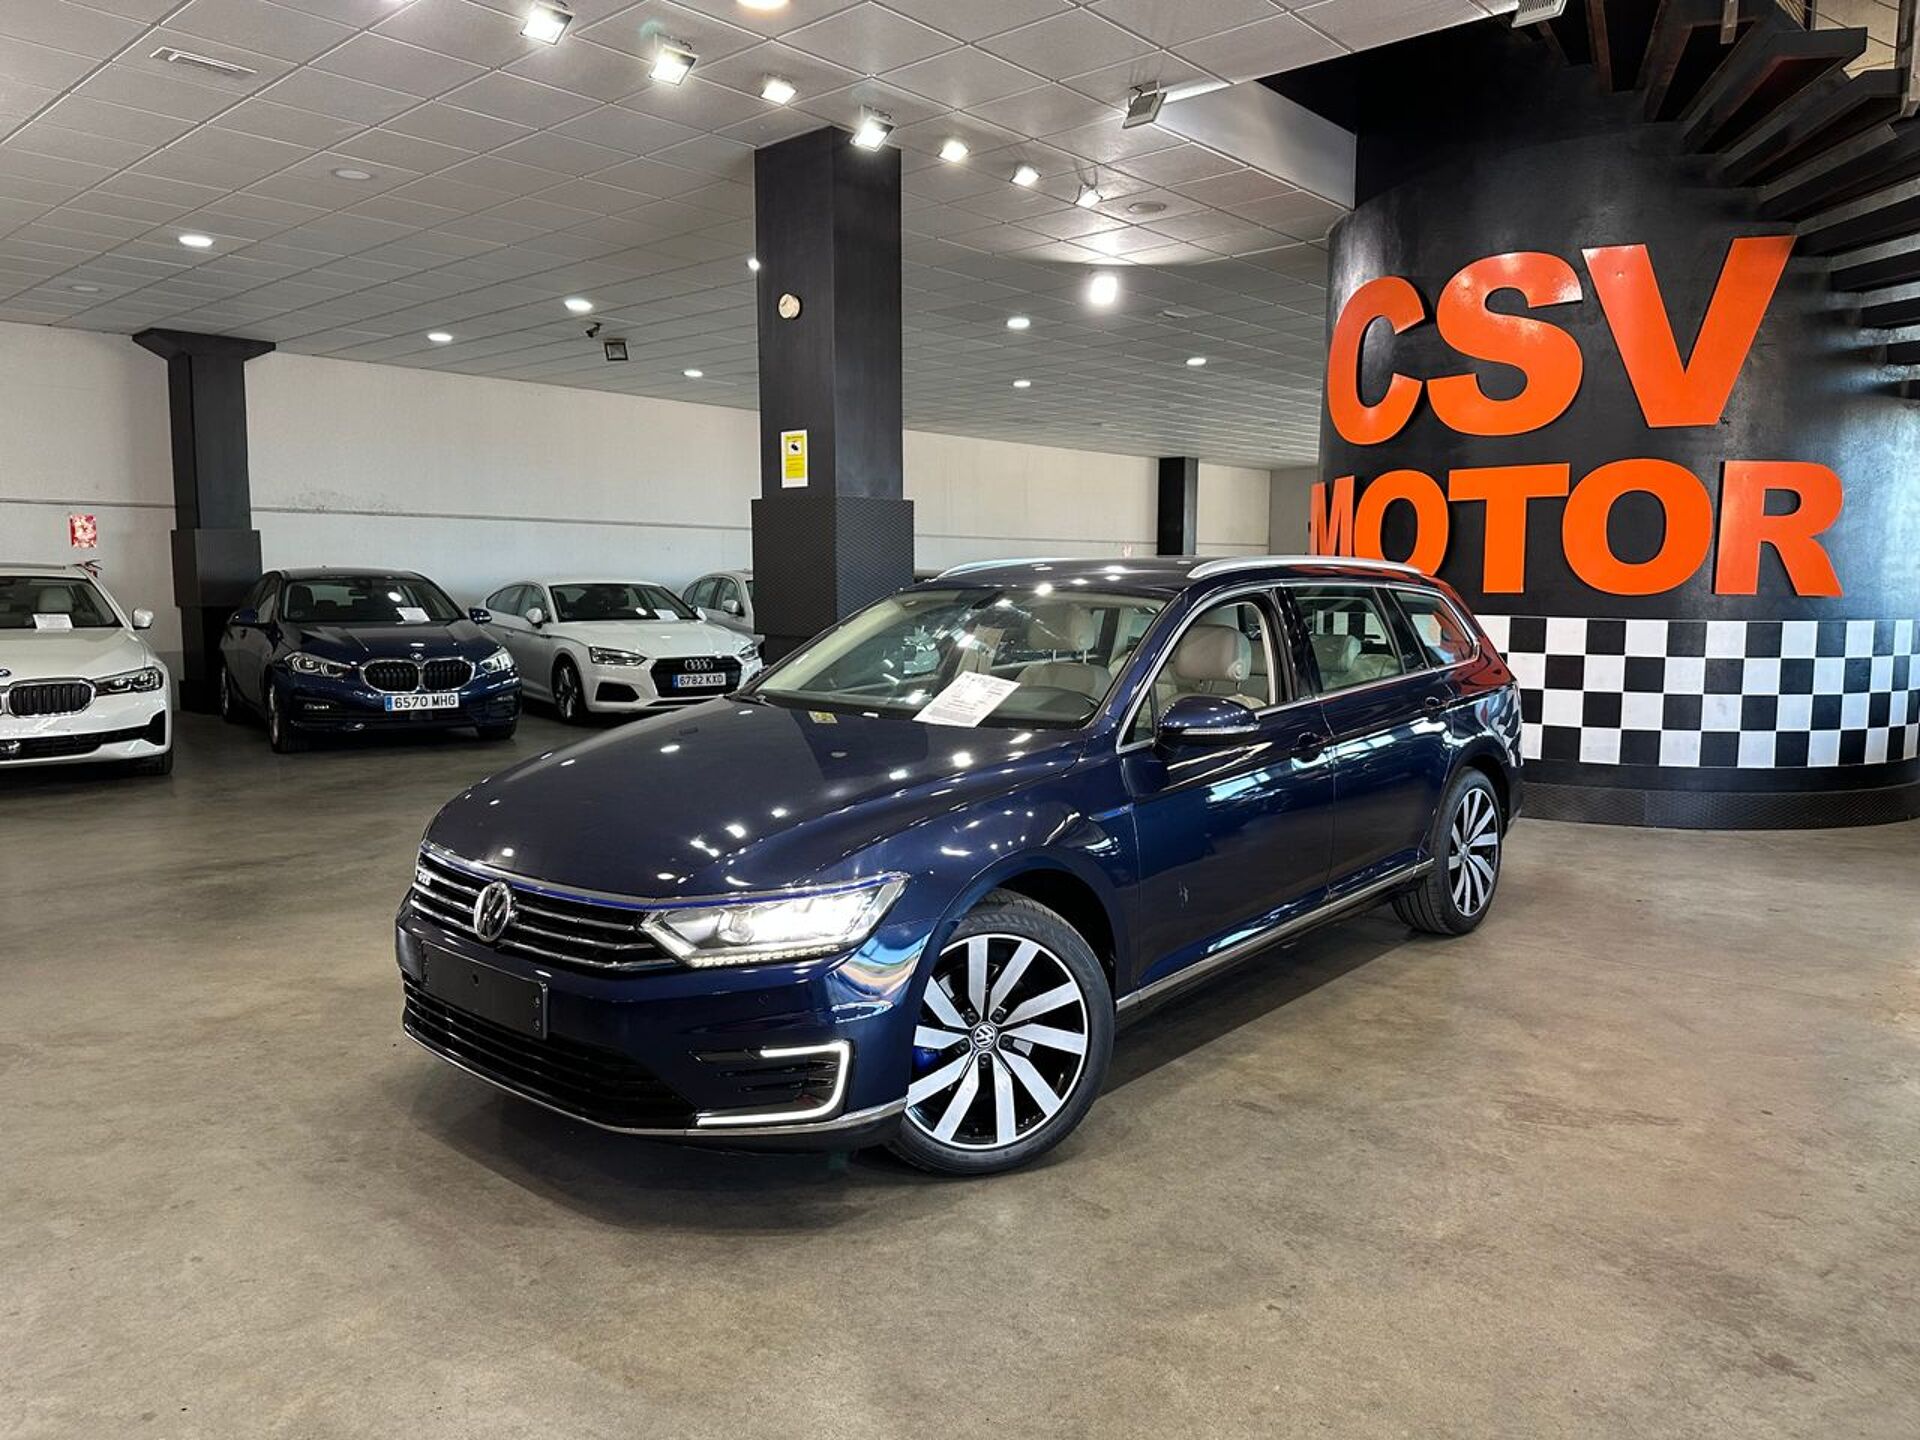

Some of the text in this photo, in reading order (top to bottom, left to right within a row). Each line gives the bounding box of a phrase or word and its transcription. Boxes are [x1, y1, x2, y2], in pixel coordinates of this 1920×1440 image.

[1327, 235, 1798, 446] CSV
[1309, 457, 1844, 597] MOTOR
[394, 694, 456, 709] 6570 MHG
[680, 675, 704, 687] 6782
